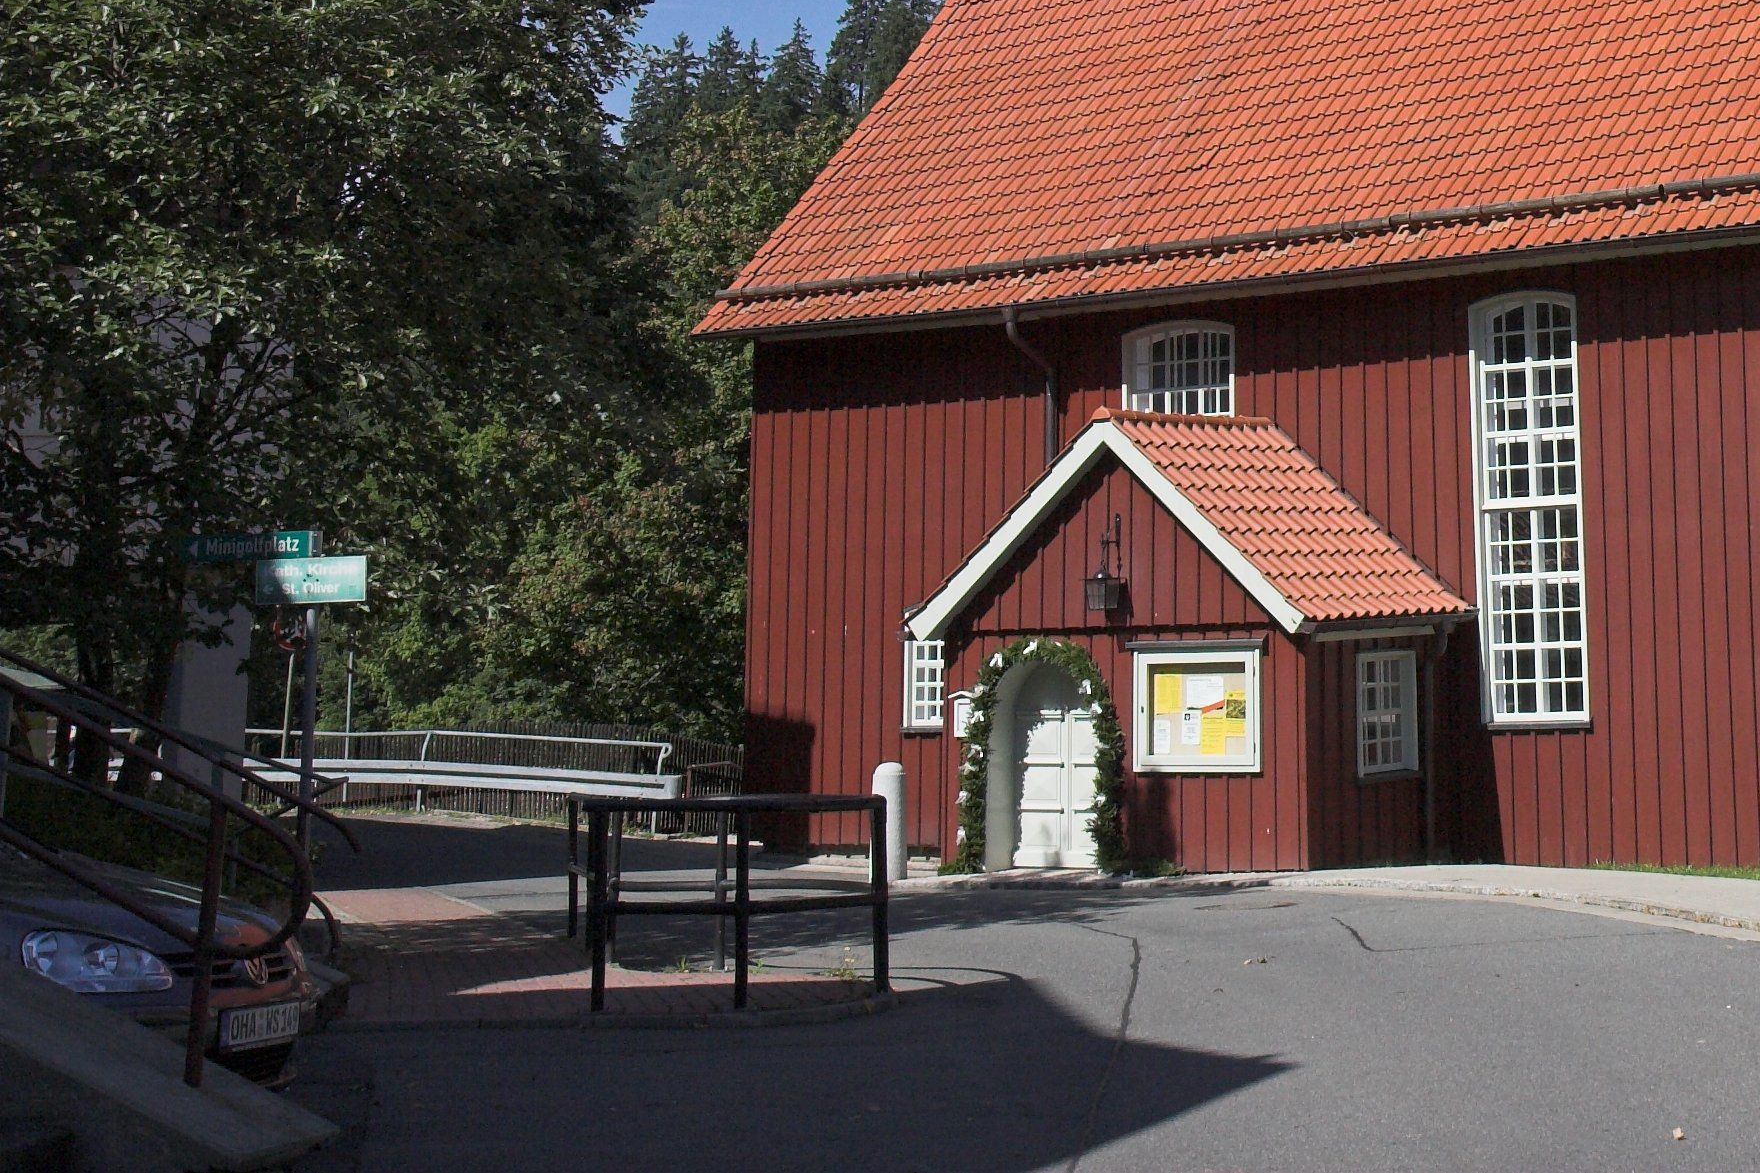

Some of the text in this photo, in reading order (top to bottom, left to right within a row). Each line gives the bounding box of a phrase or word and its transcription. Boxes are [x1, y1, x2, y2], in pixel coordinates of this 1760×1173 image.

[206, 536, 300, 558] Minigolfplatz
[308, 563, 359, 576] Kirche
[282, 582, 341, 595] St. Oliver
[231, 1011, 256, 1041] OHA
